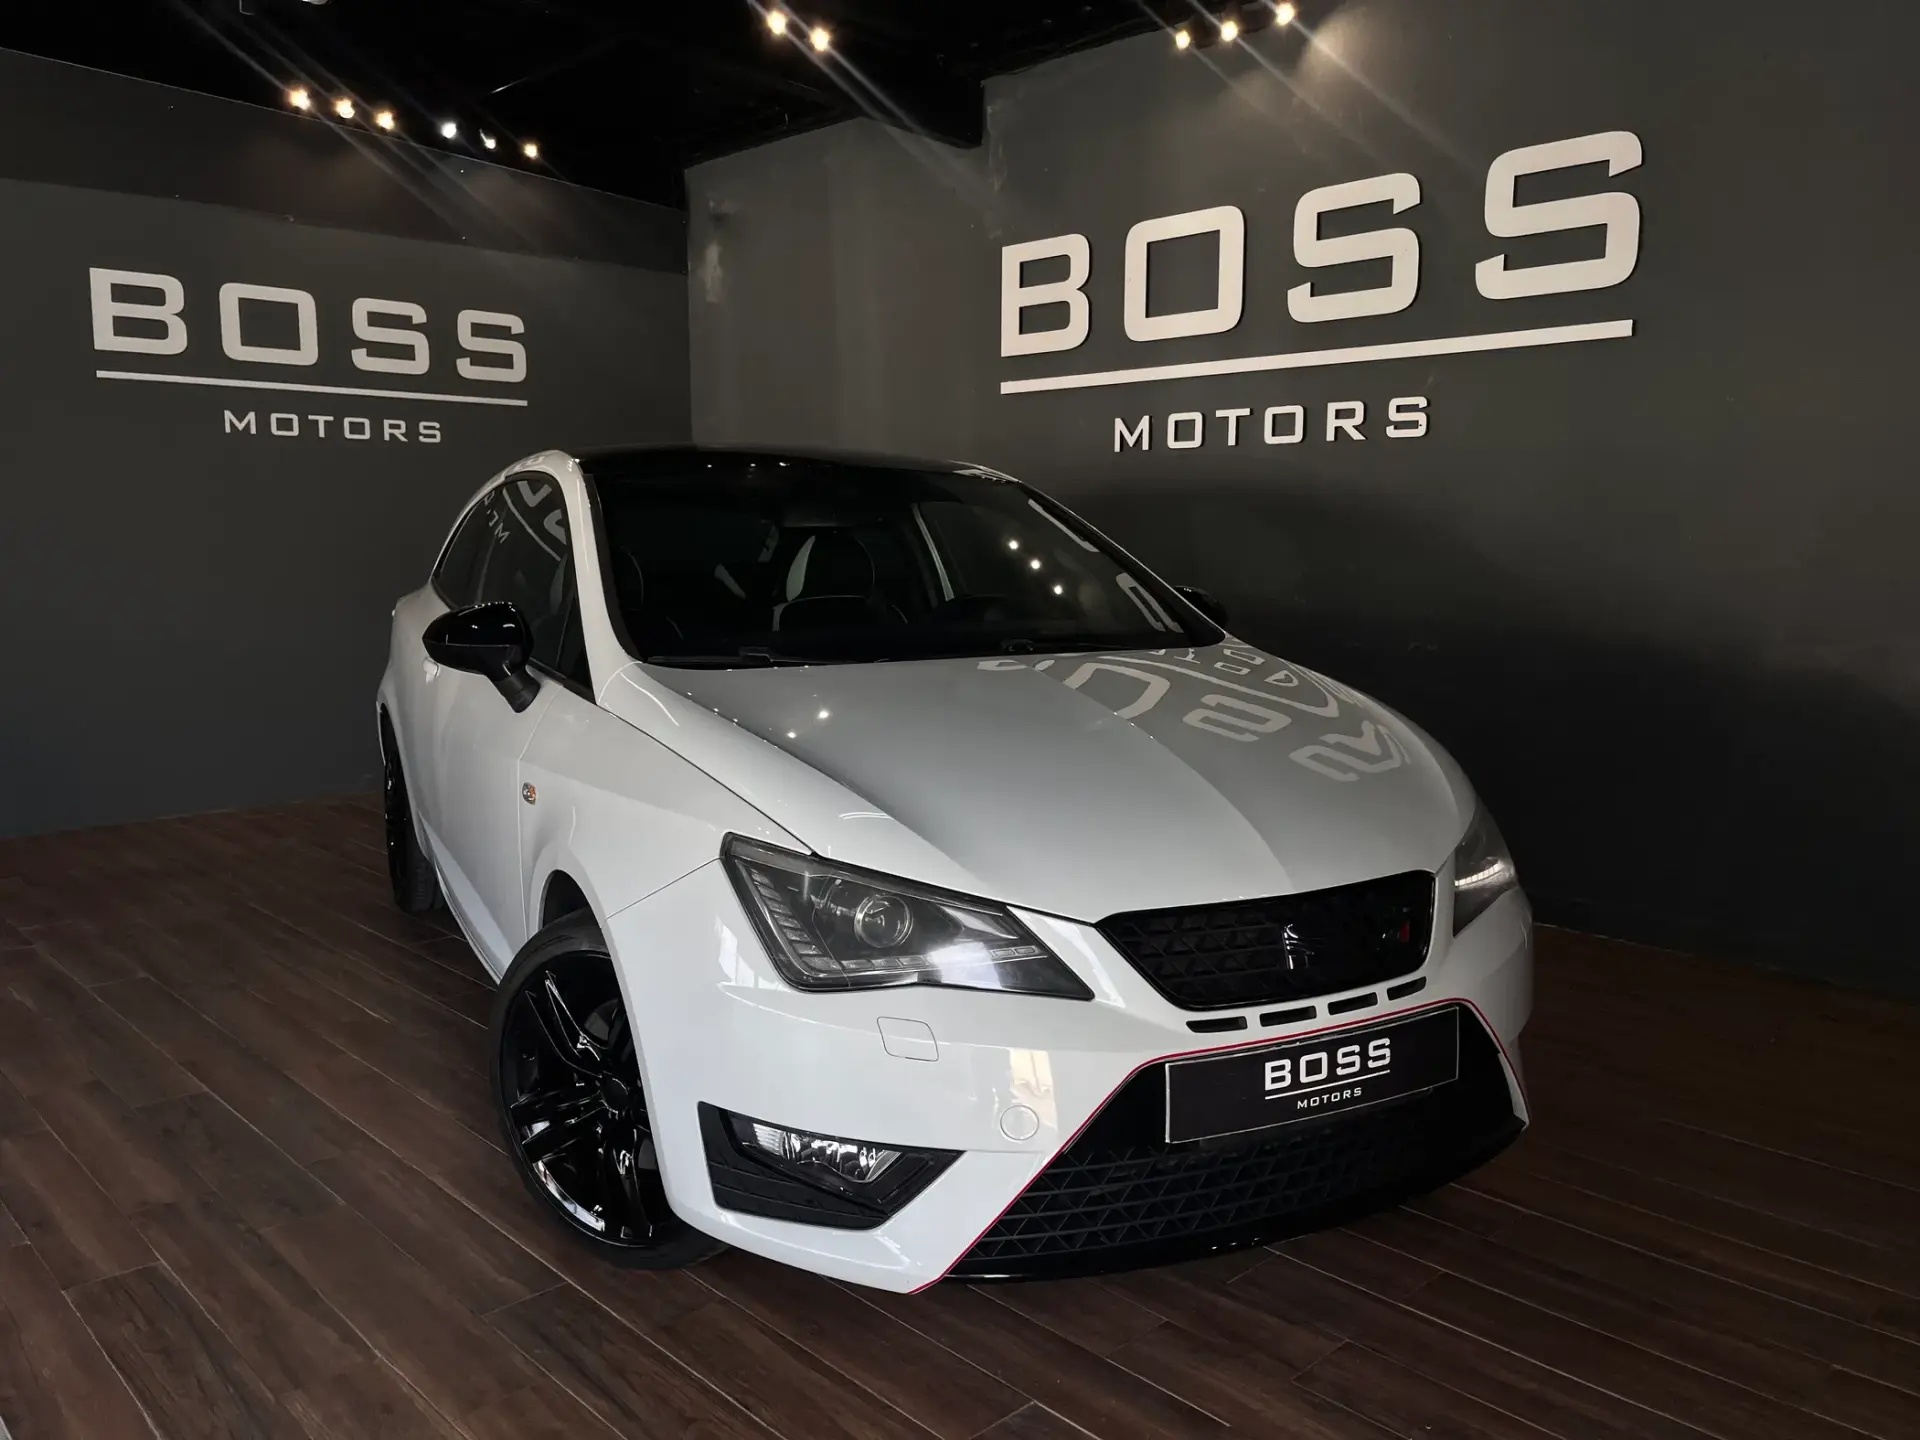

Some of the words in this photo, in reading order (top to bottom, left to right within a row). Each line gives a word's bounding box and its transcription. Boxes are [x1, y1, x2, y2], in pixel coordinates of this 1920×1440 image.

[1000, 130, 1643, 358] BOSS
[89, 267, 527, 383] BOSS
[223, 410, 442, 443] MOTORS
[1113, 396, 1429, 453] MOTORS
[1264, 1037, 1391, 1091] BOSS
[1296, 1087, 1363, 1110] MOTORS
